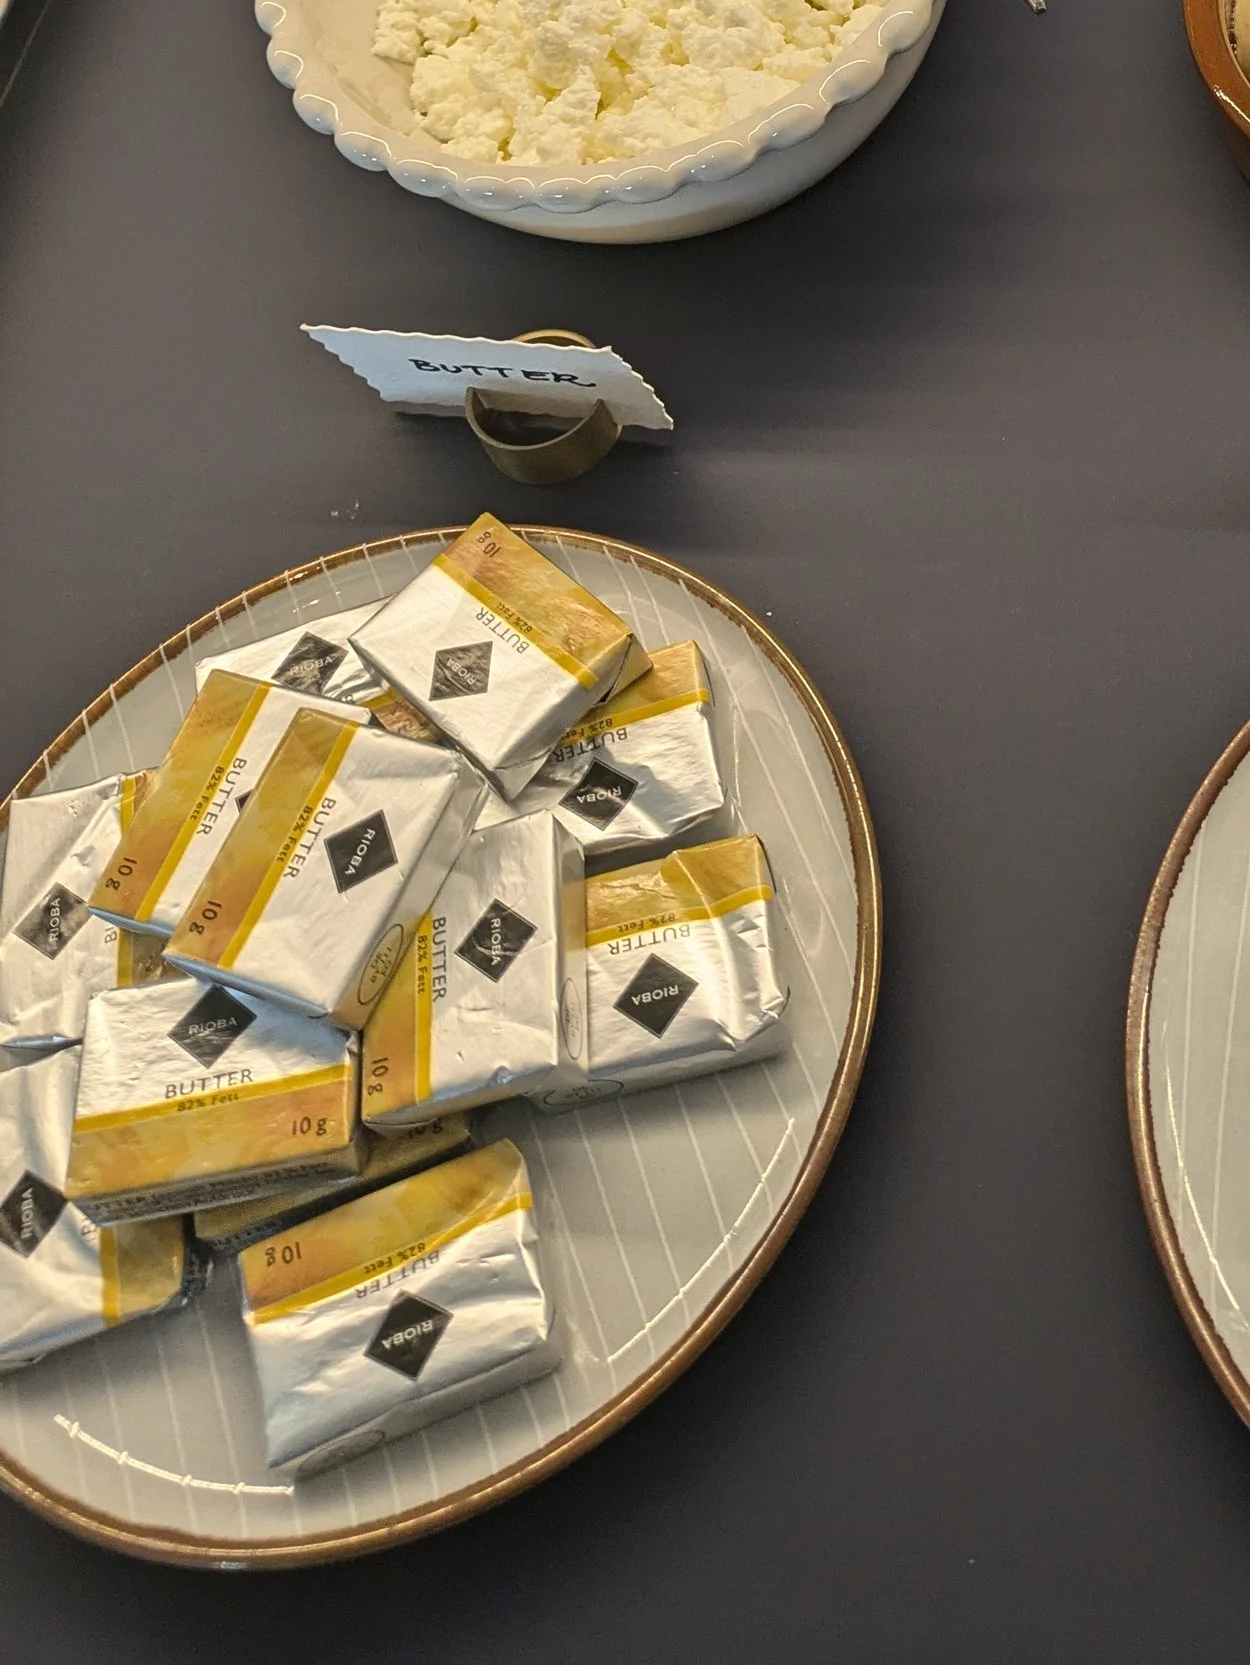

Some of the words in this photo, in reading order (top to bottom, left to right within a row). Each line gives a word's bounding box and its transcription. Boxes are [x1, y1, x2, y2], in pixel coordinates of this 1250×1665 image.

[408, 358, 597, 388] BUTTER
[475, 606, 531, 654] BUTTER
[288, 654, 336, 677] RIOBA
[445, 656, 477, 686] RIOBA
[553, 727, 628, 763] BUTTER
[196, 757, 248, 836] BUTTER
[576, 785, 622, 805] RIOBA
[283, 797, 337, 880] BUTTER
[344, 828, 377, 877] RIOBA
[118, 857, 138, 877] 10
[49, 897, 62, 943] RIOBA
[202, 900, 222, 922] 10
[490, 917, 504, 967] RIOBA
[607, 924, 691, 956] BUTTER
[432, 916, 448, 1003] BUTTER
[631, 984, 680, 1007] RIOBA
[188, 1016, 238, 1036] RIOBA
[372, 1057, 389, 1077] 10
[164, 1068, 254, 1100] BUTTER
[291, 1116, 312, 1136] 10
[281, 1241, 303, 1265] 10
[355, 1249, 440, 1300] BUTTER
[381, 1319, 434, 1351] RIOBA
